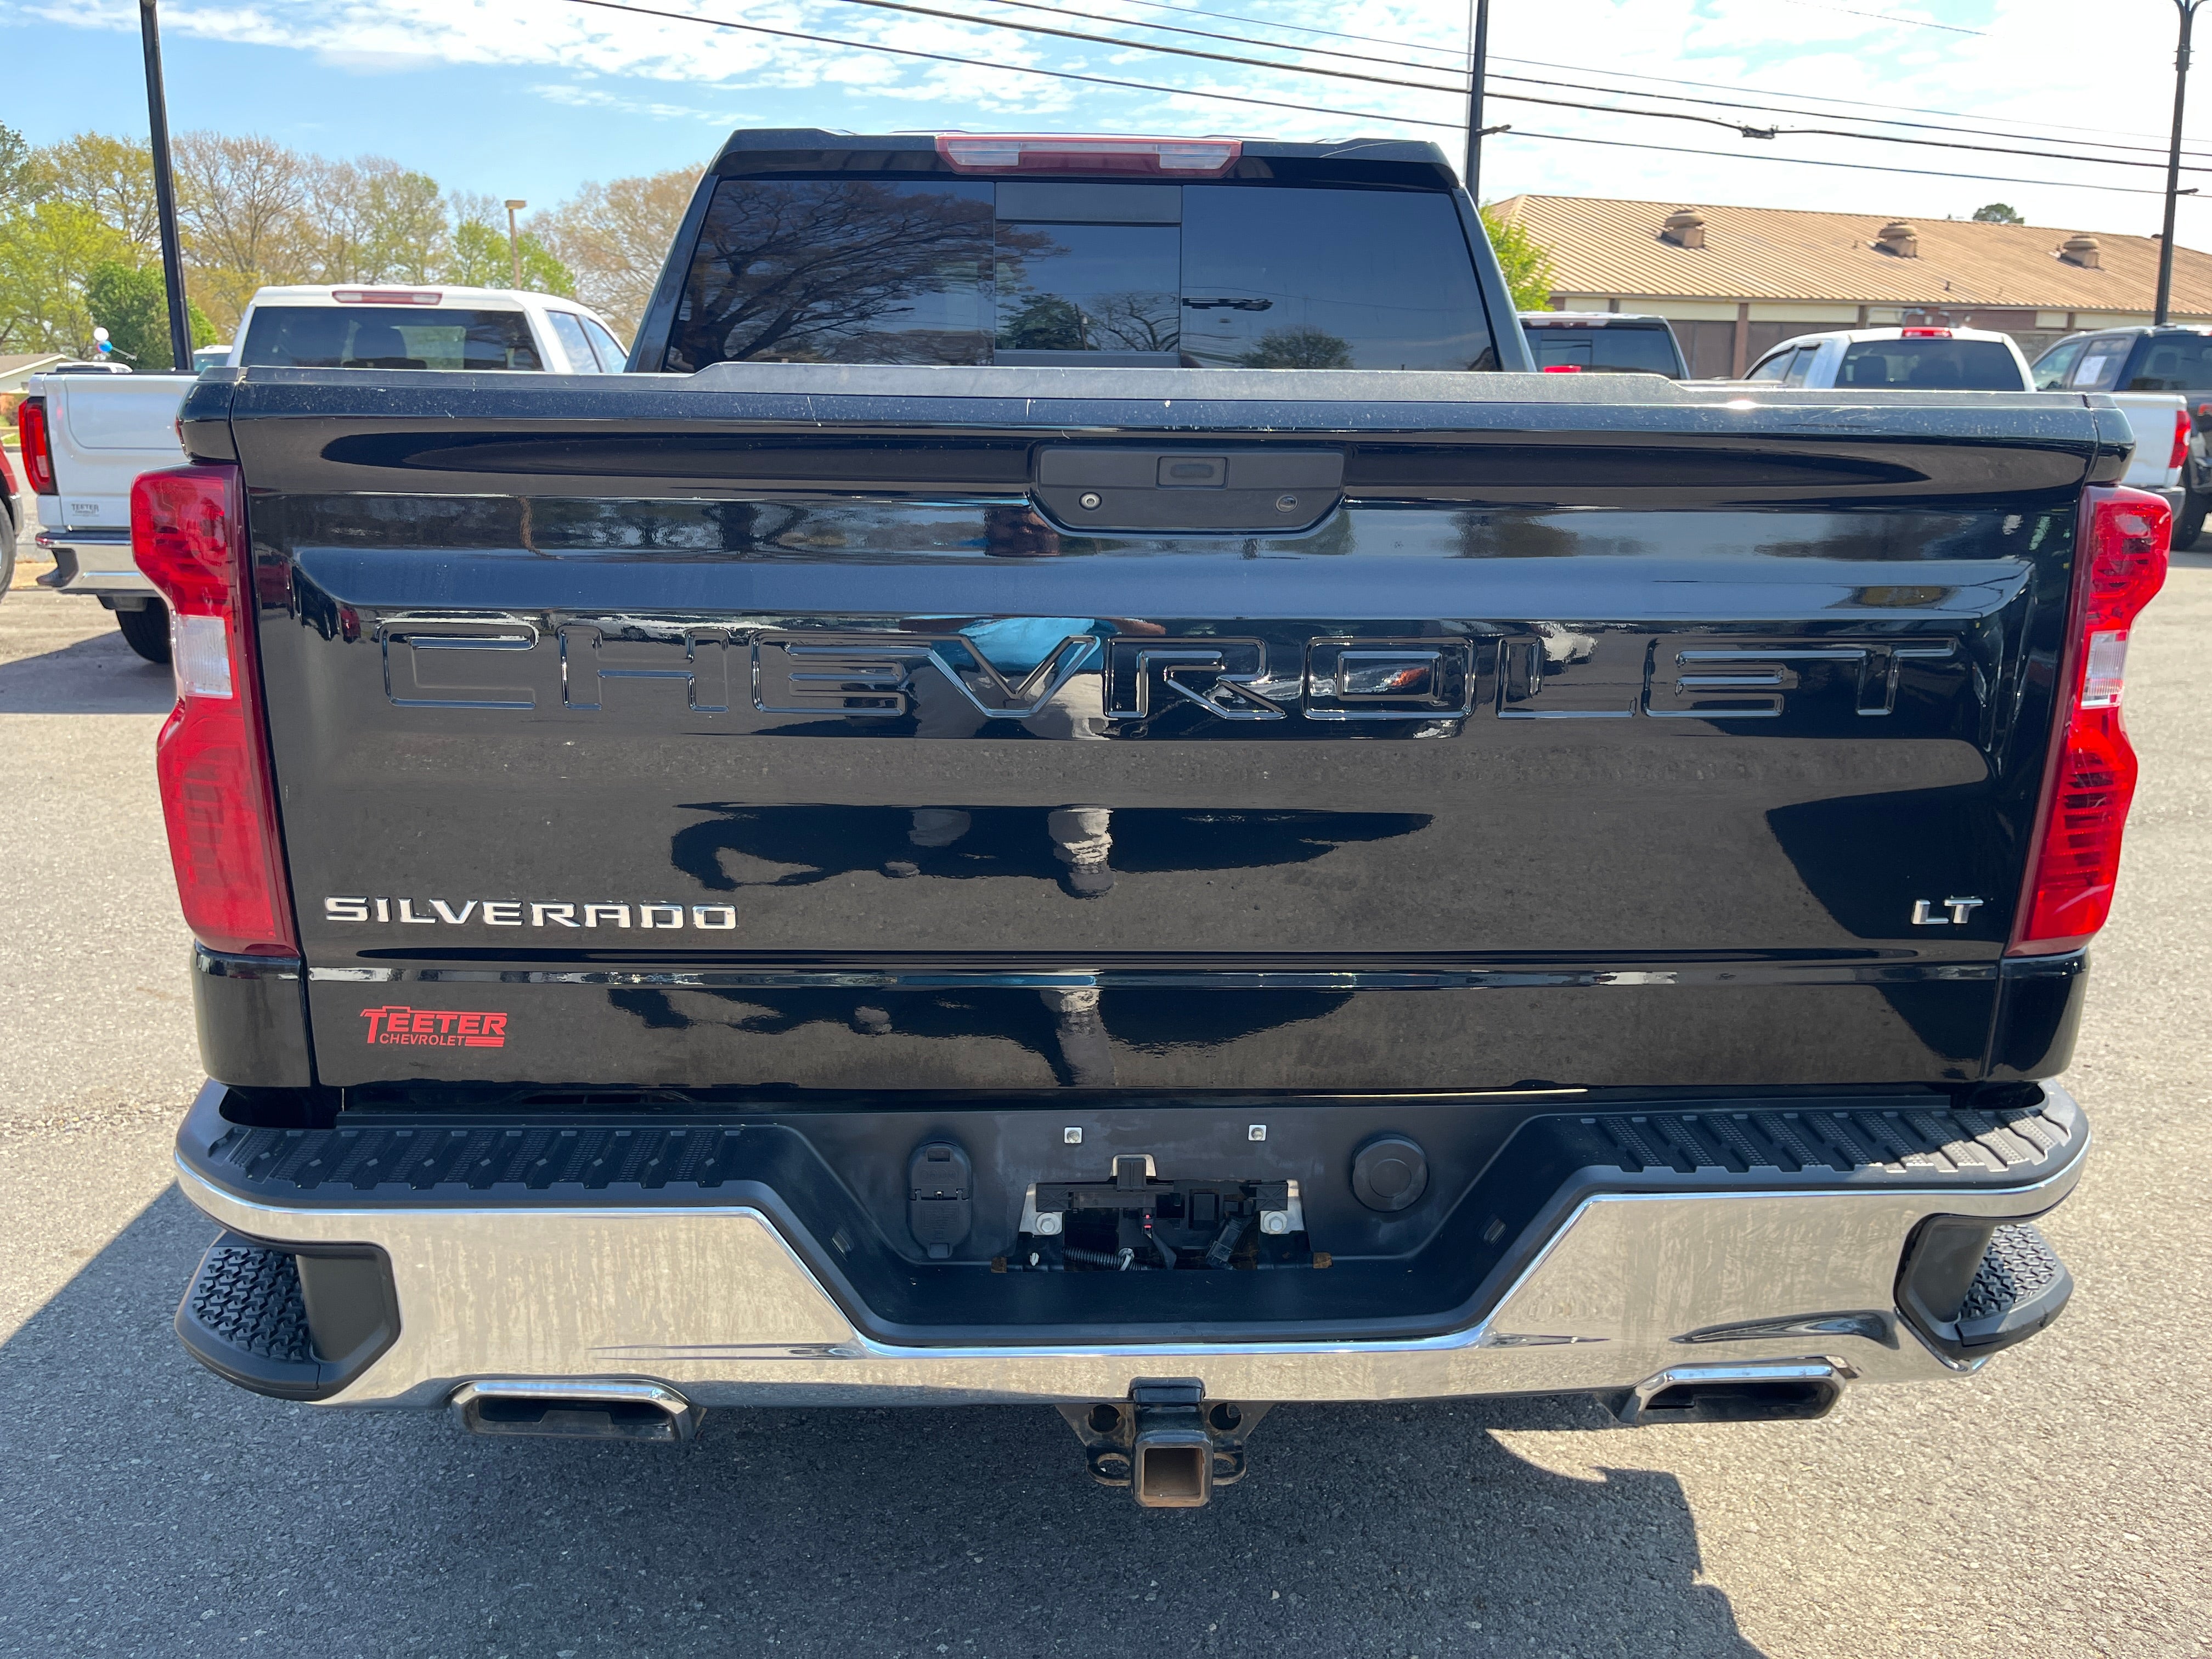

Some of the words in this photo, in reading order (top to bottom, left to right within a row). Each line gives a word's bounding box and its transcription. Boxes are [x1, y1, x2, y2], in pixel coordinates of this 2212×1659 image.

[380, 620, 1959, 720] CHEVROLET
[325, 896, 737, 930] SILVERADO
[1911, 898, 1984, 924] LT
[363, 1011, 507, 1043] TEETER
[379, 1033, 465, 1046] CHEVROLET
